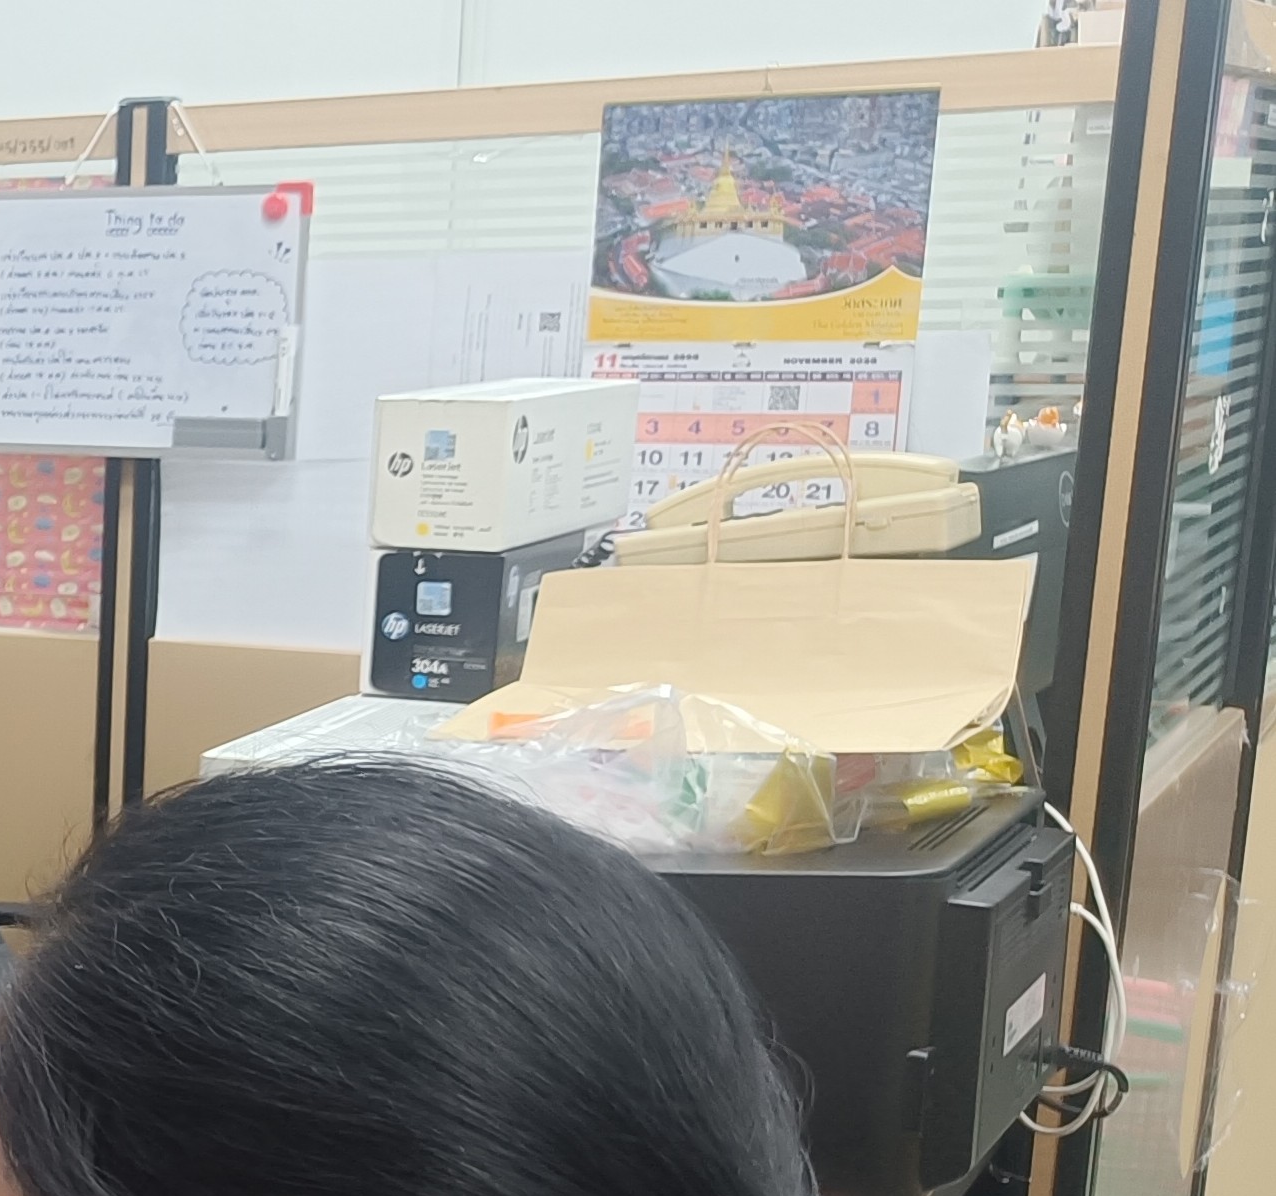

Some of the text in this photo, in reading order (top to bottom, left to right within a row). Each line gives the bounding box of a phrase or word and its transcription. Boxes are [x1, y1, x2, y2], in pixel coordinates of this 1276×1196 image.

[645, 420, 659, 435] 3
[687, 420, 701, 434] 4
[732, 420, 745, 435] 5
[865, 421, 879, 437] 8
[637, 450, 703, 465] 10 11
[634, 480, 832, 499] 17 20 21
[630, 511, 645, 527] 2
[383, 612, 409, 640] hp
[412, 658, 448, 674] 304A
